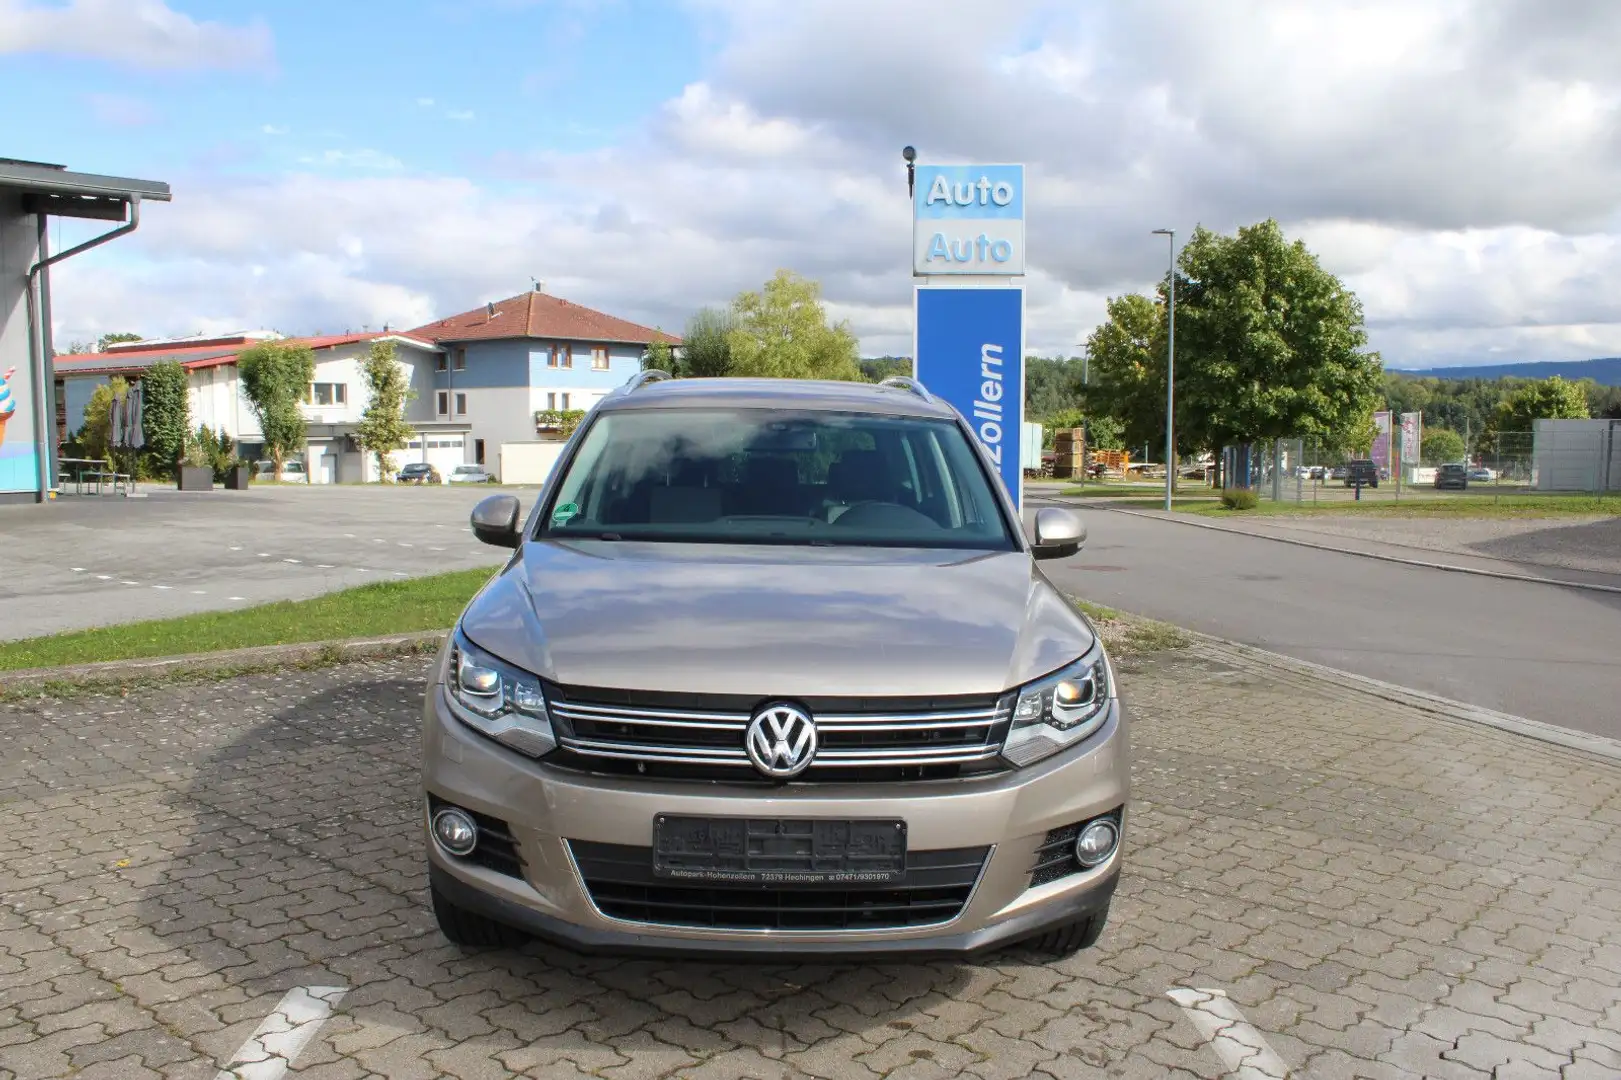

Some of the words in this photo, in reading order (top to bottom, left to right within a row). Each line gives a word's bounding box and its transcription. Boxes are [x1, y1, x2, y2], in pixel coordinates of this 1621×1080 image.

[926, 175, 1014, 206] Auto
[927, 231, 1013, 262] Auto
[973, 343, 1003, 473] zollern
[749, 707, 814, 774] VW
[784, 873, 824, 883] Hechingen
